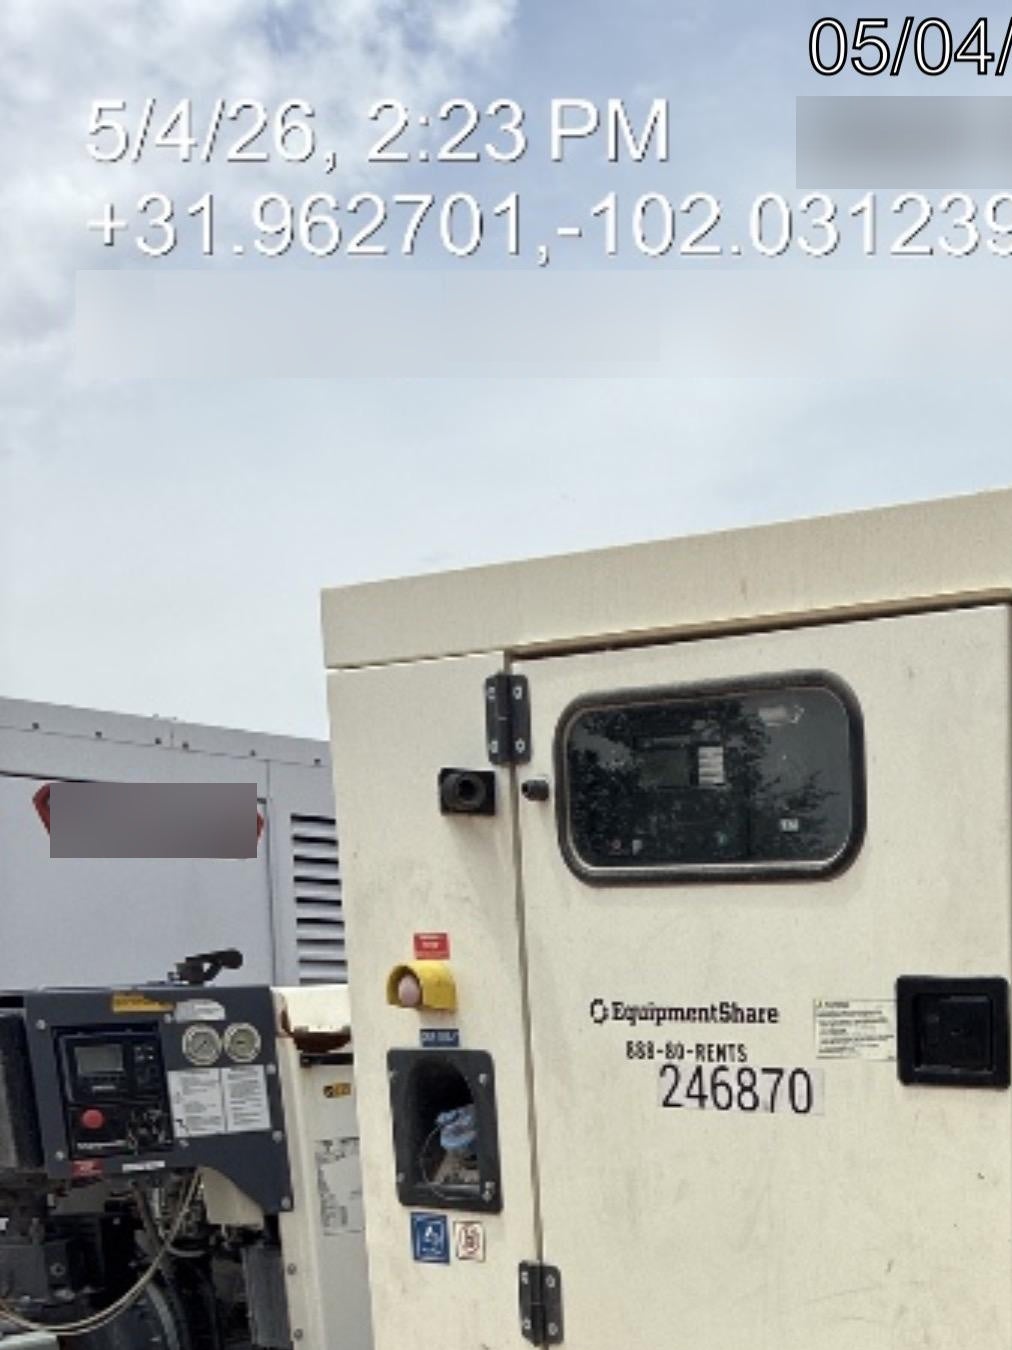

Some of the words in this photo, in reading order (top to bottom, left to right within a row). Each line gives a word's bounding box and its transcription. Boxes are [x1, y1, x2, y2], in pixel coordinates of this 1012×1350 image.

[611, 1000, 780, 1027] EquipmentShare
[626, 1040, 748, 1063] 888-80-RENTS
[659, 1063, 814, 1114] 246870
